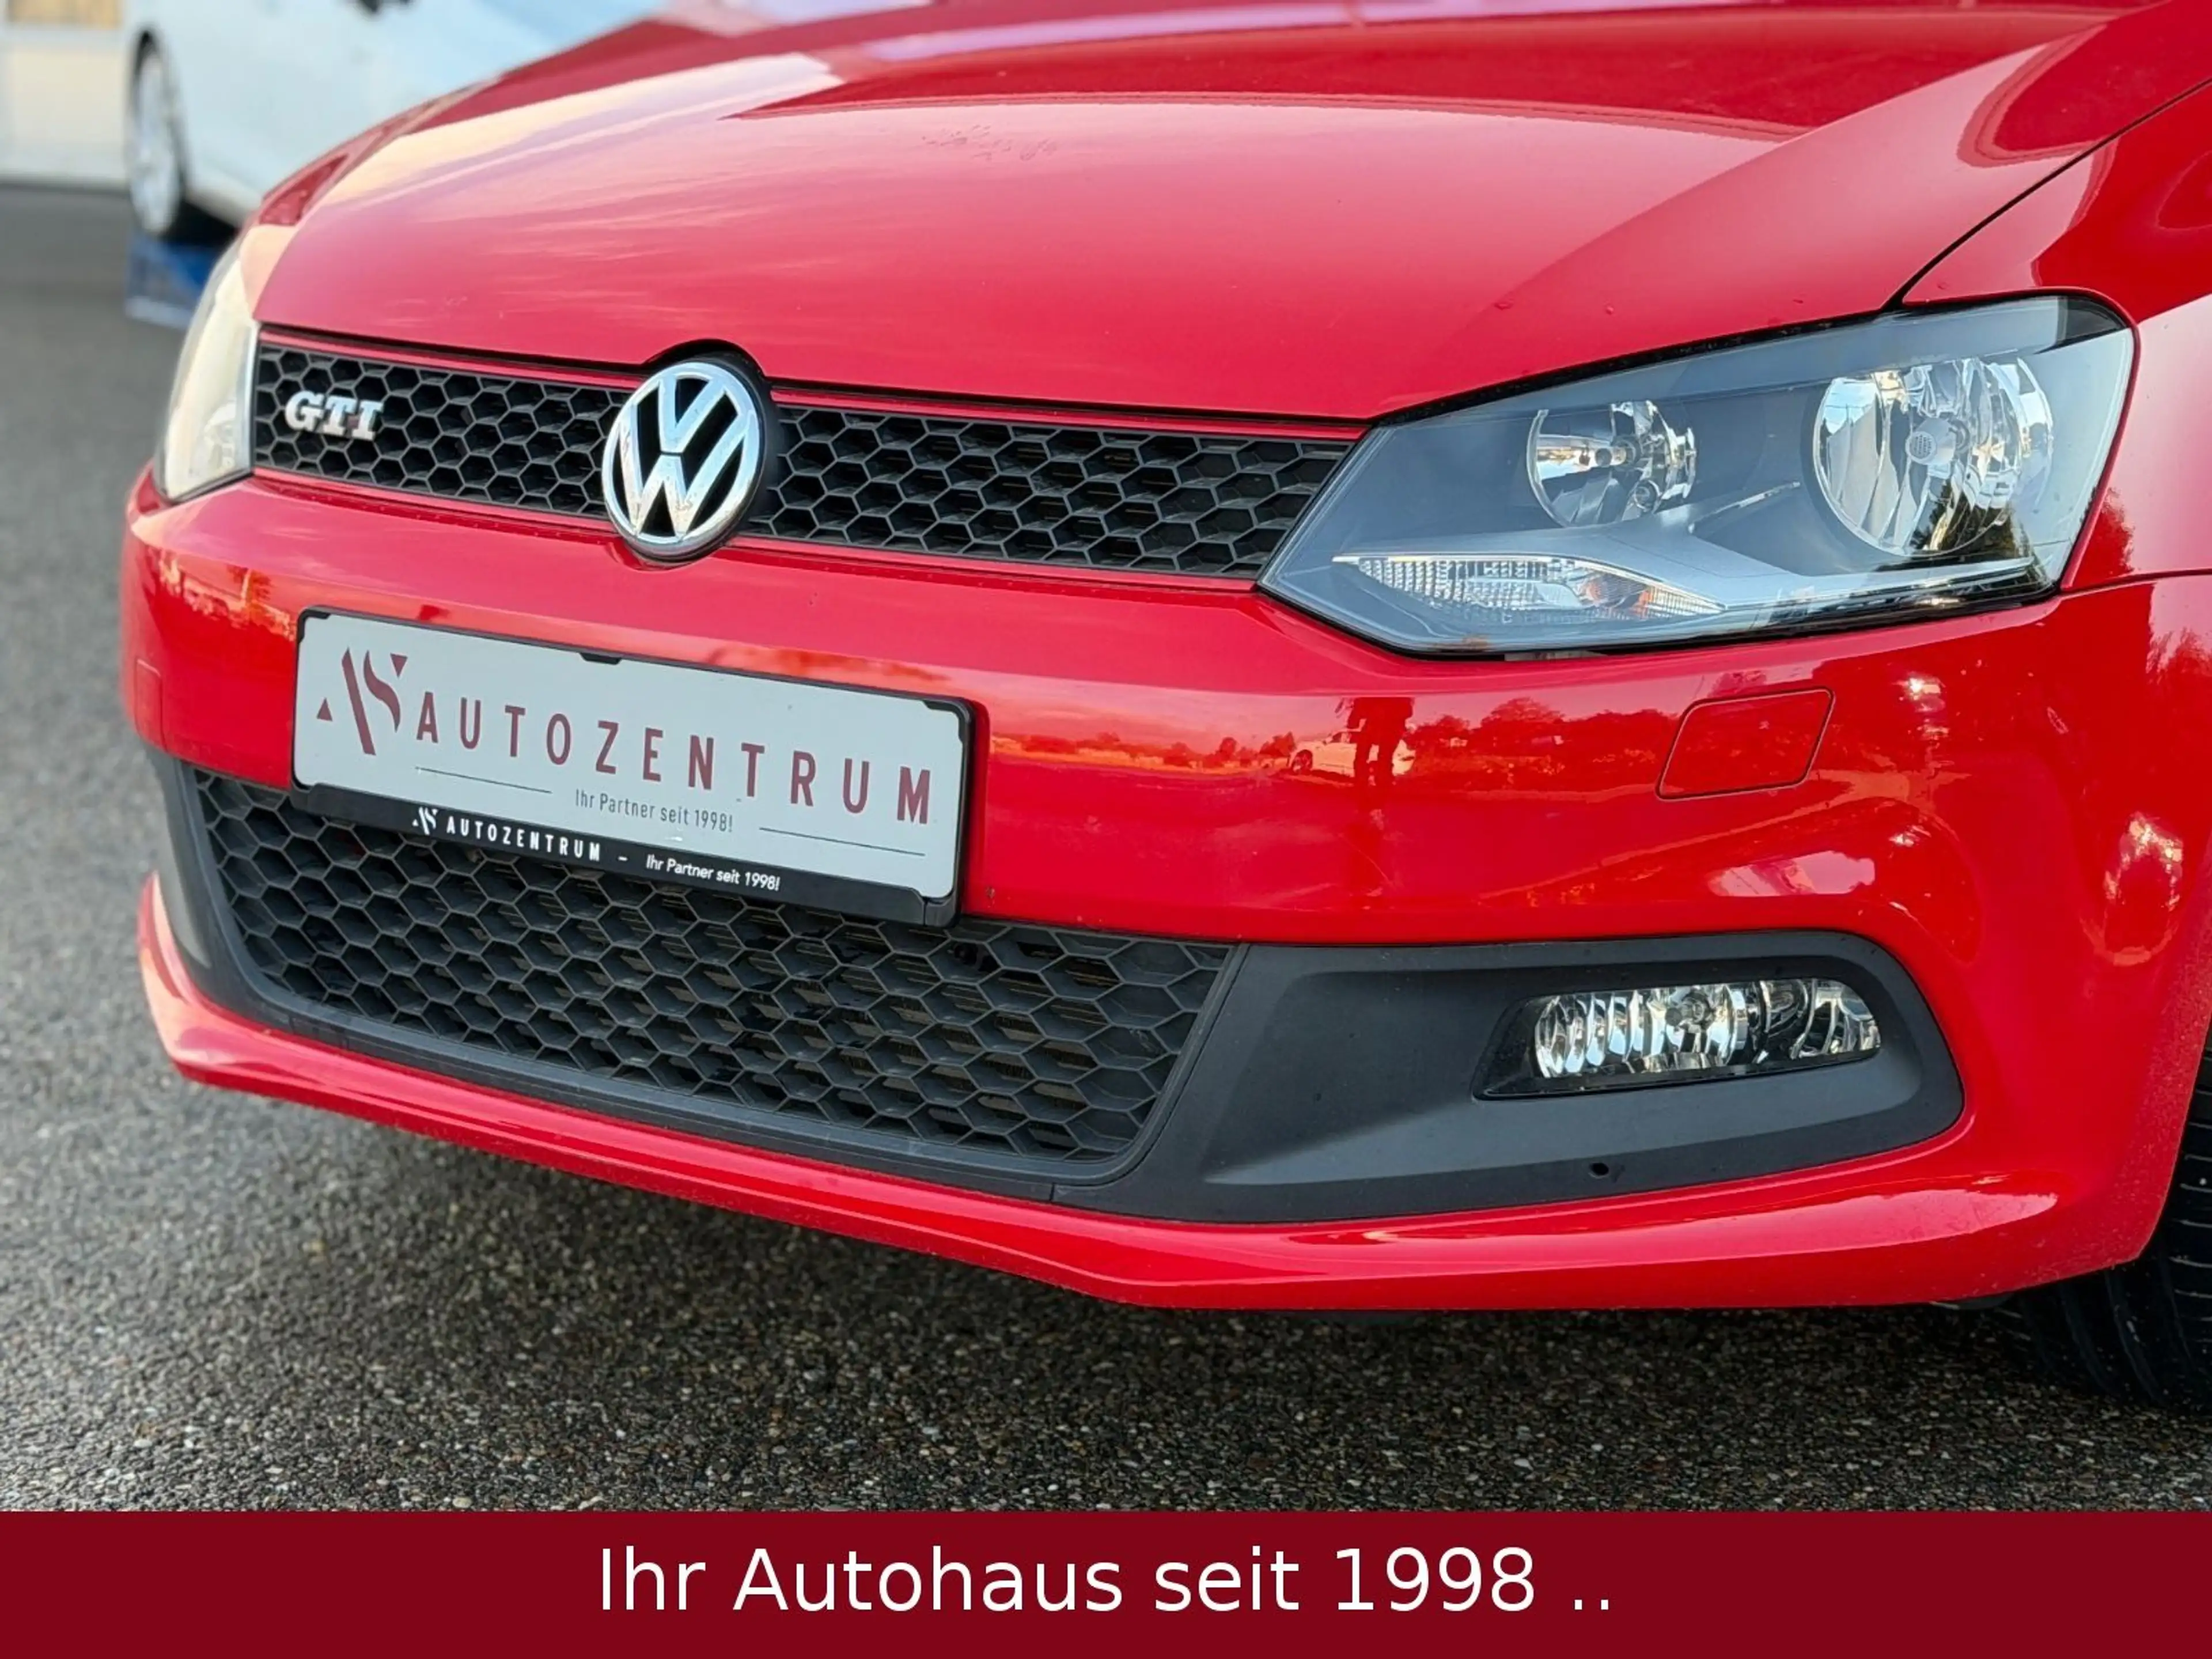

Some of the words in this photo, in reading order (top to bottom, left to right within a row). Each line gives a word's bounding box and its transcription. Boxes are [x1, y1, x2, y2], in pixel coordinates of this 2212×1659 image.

[285, 389, 383, 441] GTI
[416, 691, 932, 825] AUTOZENTRUM
[576, 789, 595, 808] Ihr
[600, 793, 655, 819] Partner
[660, 806, 690, 825] seit
[695, 809, 733, 833] 1998!
[446, 816, 601, 861] AUTOZENTRUM
[646, 854, 664, 871] Ihr
[666, 858, 713, 880] Partner
[716, 869, 741, 884] seit
[745, 872, 781, 891] 1998!
